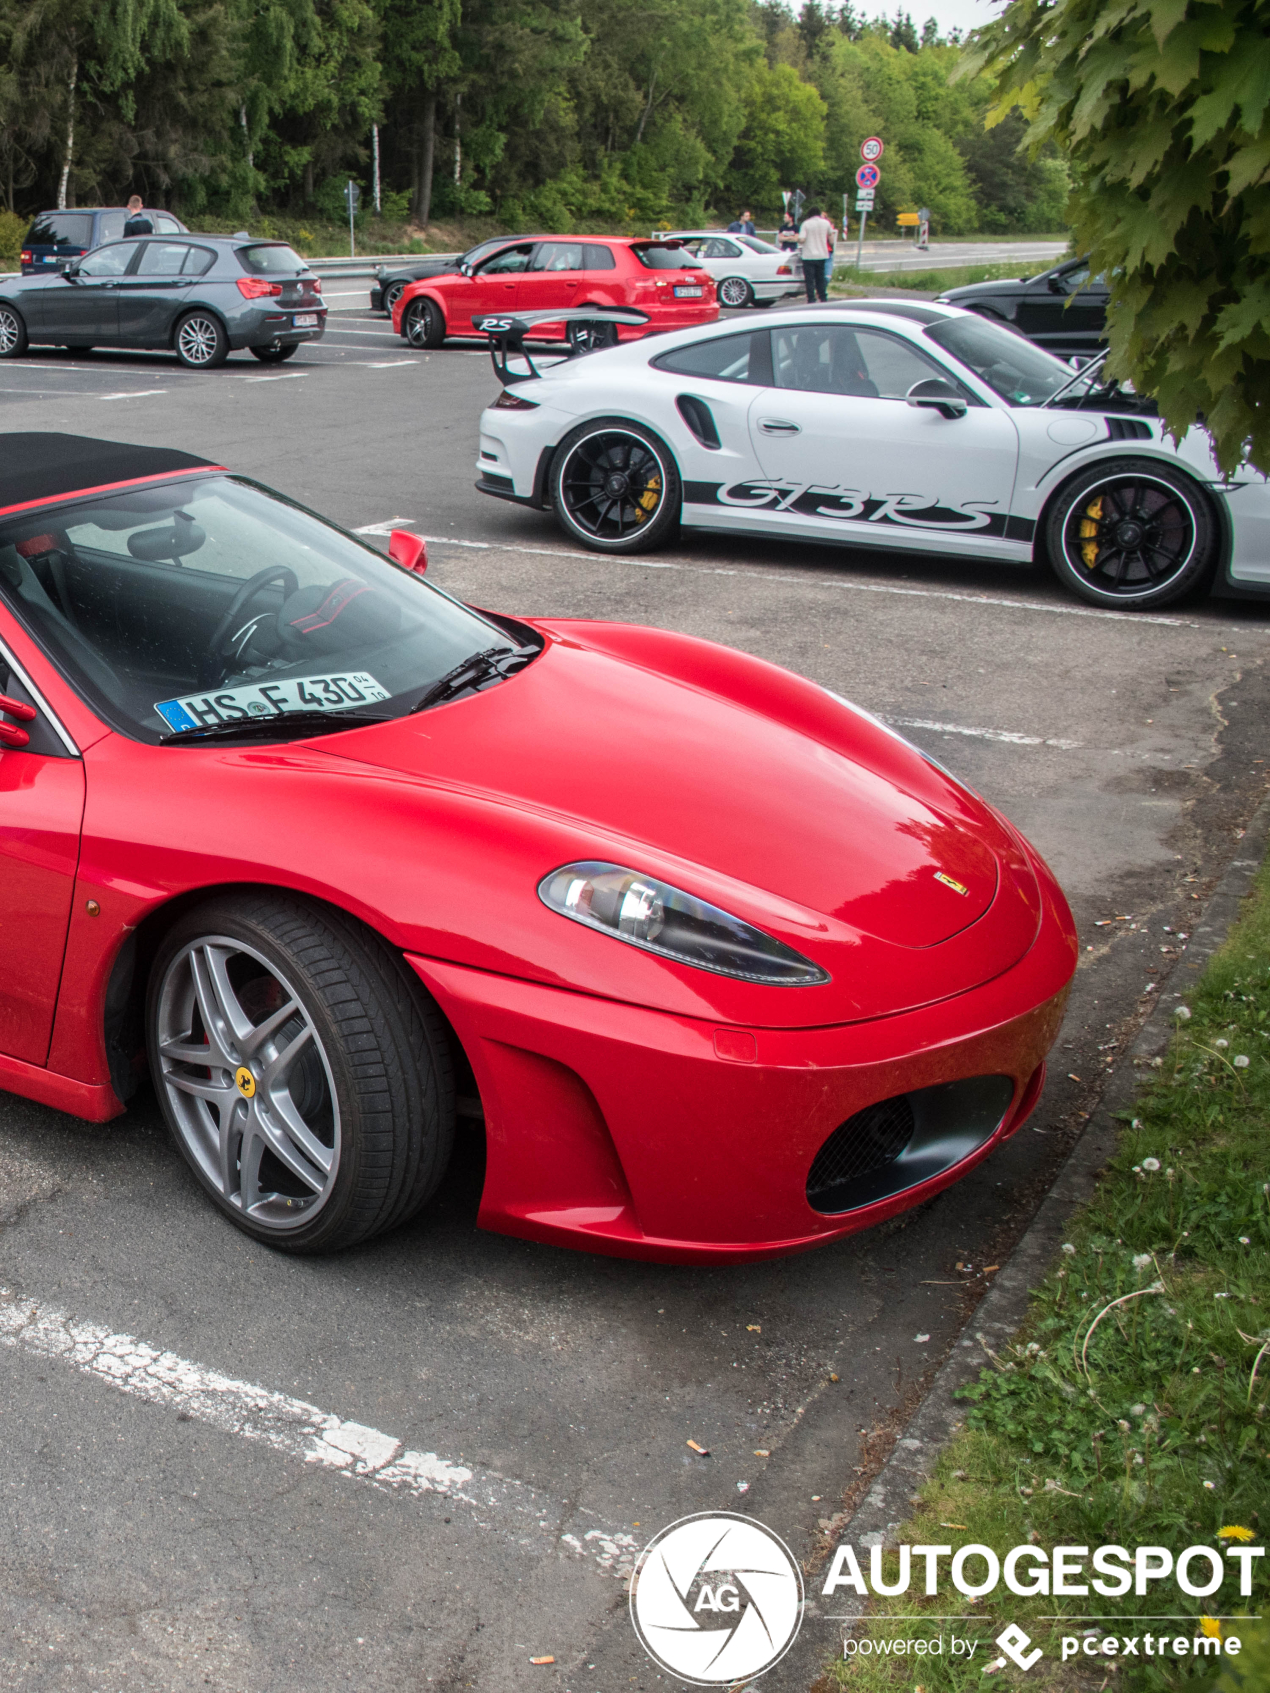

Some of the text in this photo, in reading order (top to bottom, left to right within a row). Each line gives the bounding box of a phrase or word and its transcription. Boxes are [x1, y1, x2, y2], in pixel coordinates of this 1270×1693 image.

[866, 144, 878, 155] 50
[479, 318, 513, 332] RS
[353, 675, 369, 683] 04
[371, 691, 386, 700] 10
[186, 677, 367, 726] HS F 430
